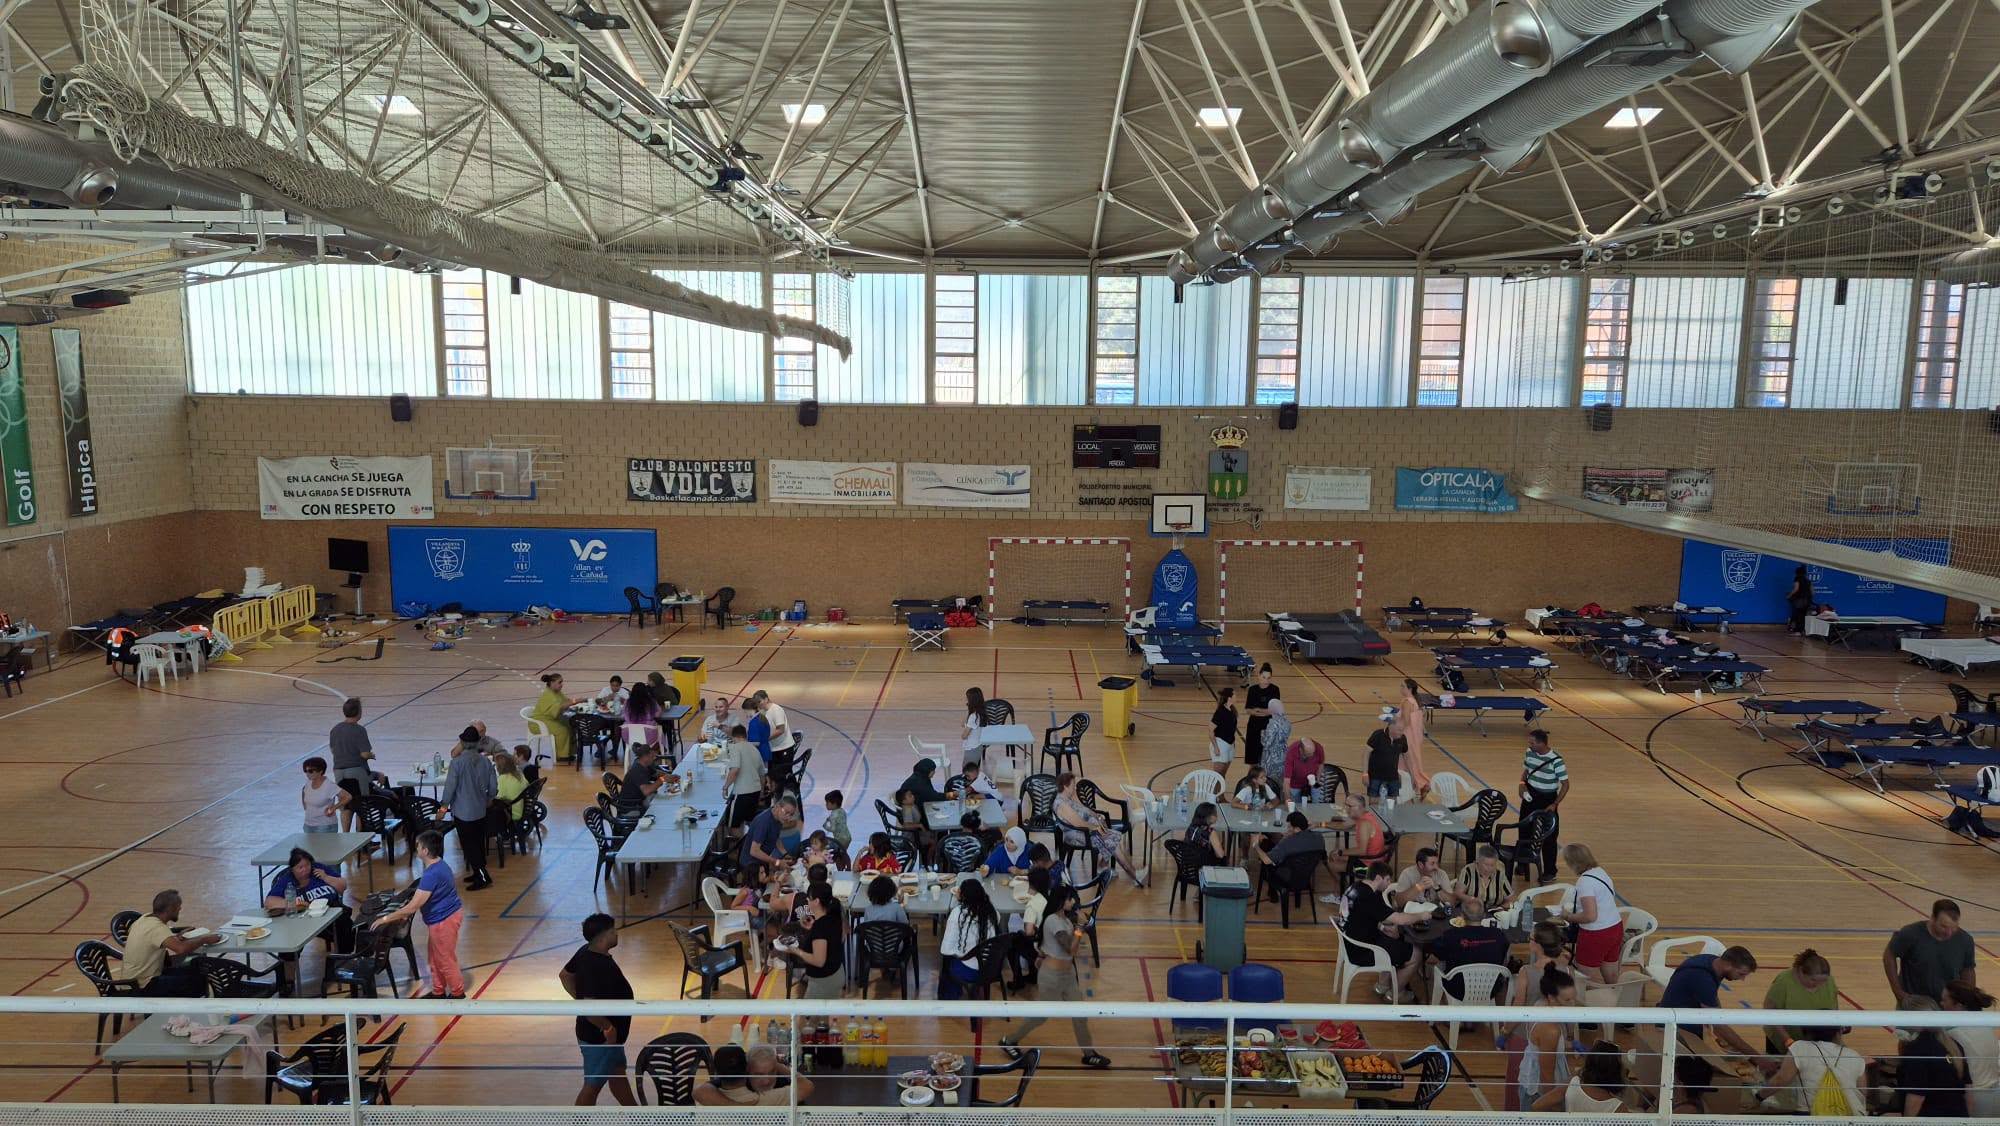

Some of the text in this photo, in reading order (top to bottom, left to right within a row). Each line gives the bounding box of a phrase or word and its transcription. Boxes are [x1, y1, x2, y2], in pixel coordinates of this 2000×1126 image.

[631, 460, 752, 472] CLUB BALONCESTO
[77, 439, 96, 512] Hípica
[286, 475, 300, 483] EN
[313, 474, 350, 482] CANCHA
[351, 473, 365, 482] SE
[367, 472, 404, 482] JUEGA
[660, 472, 723, 495] VDLC
[14, 469, 35, 521] Golf
[283, 490, 295, 498] EN
[308, 489, 339, 497] GRADA
[341, 487, 354, 497] SE
[356, 487, 412, 497] DISFRUTA
[1078, 497, 1116, 506] SANTIAGO
[301, 503, 396, 515] CON RESPETO
